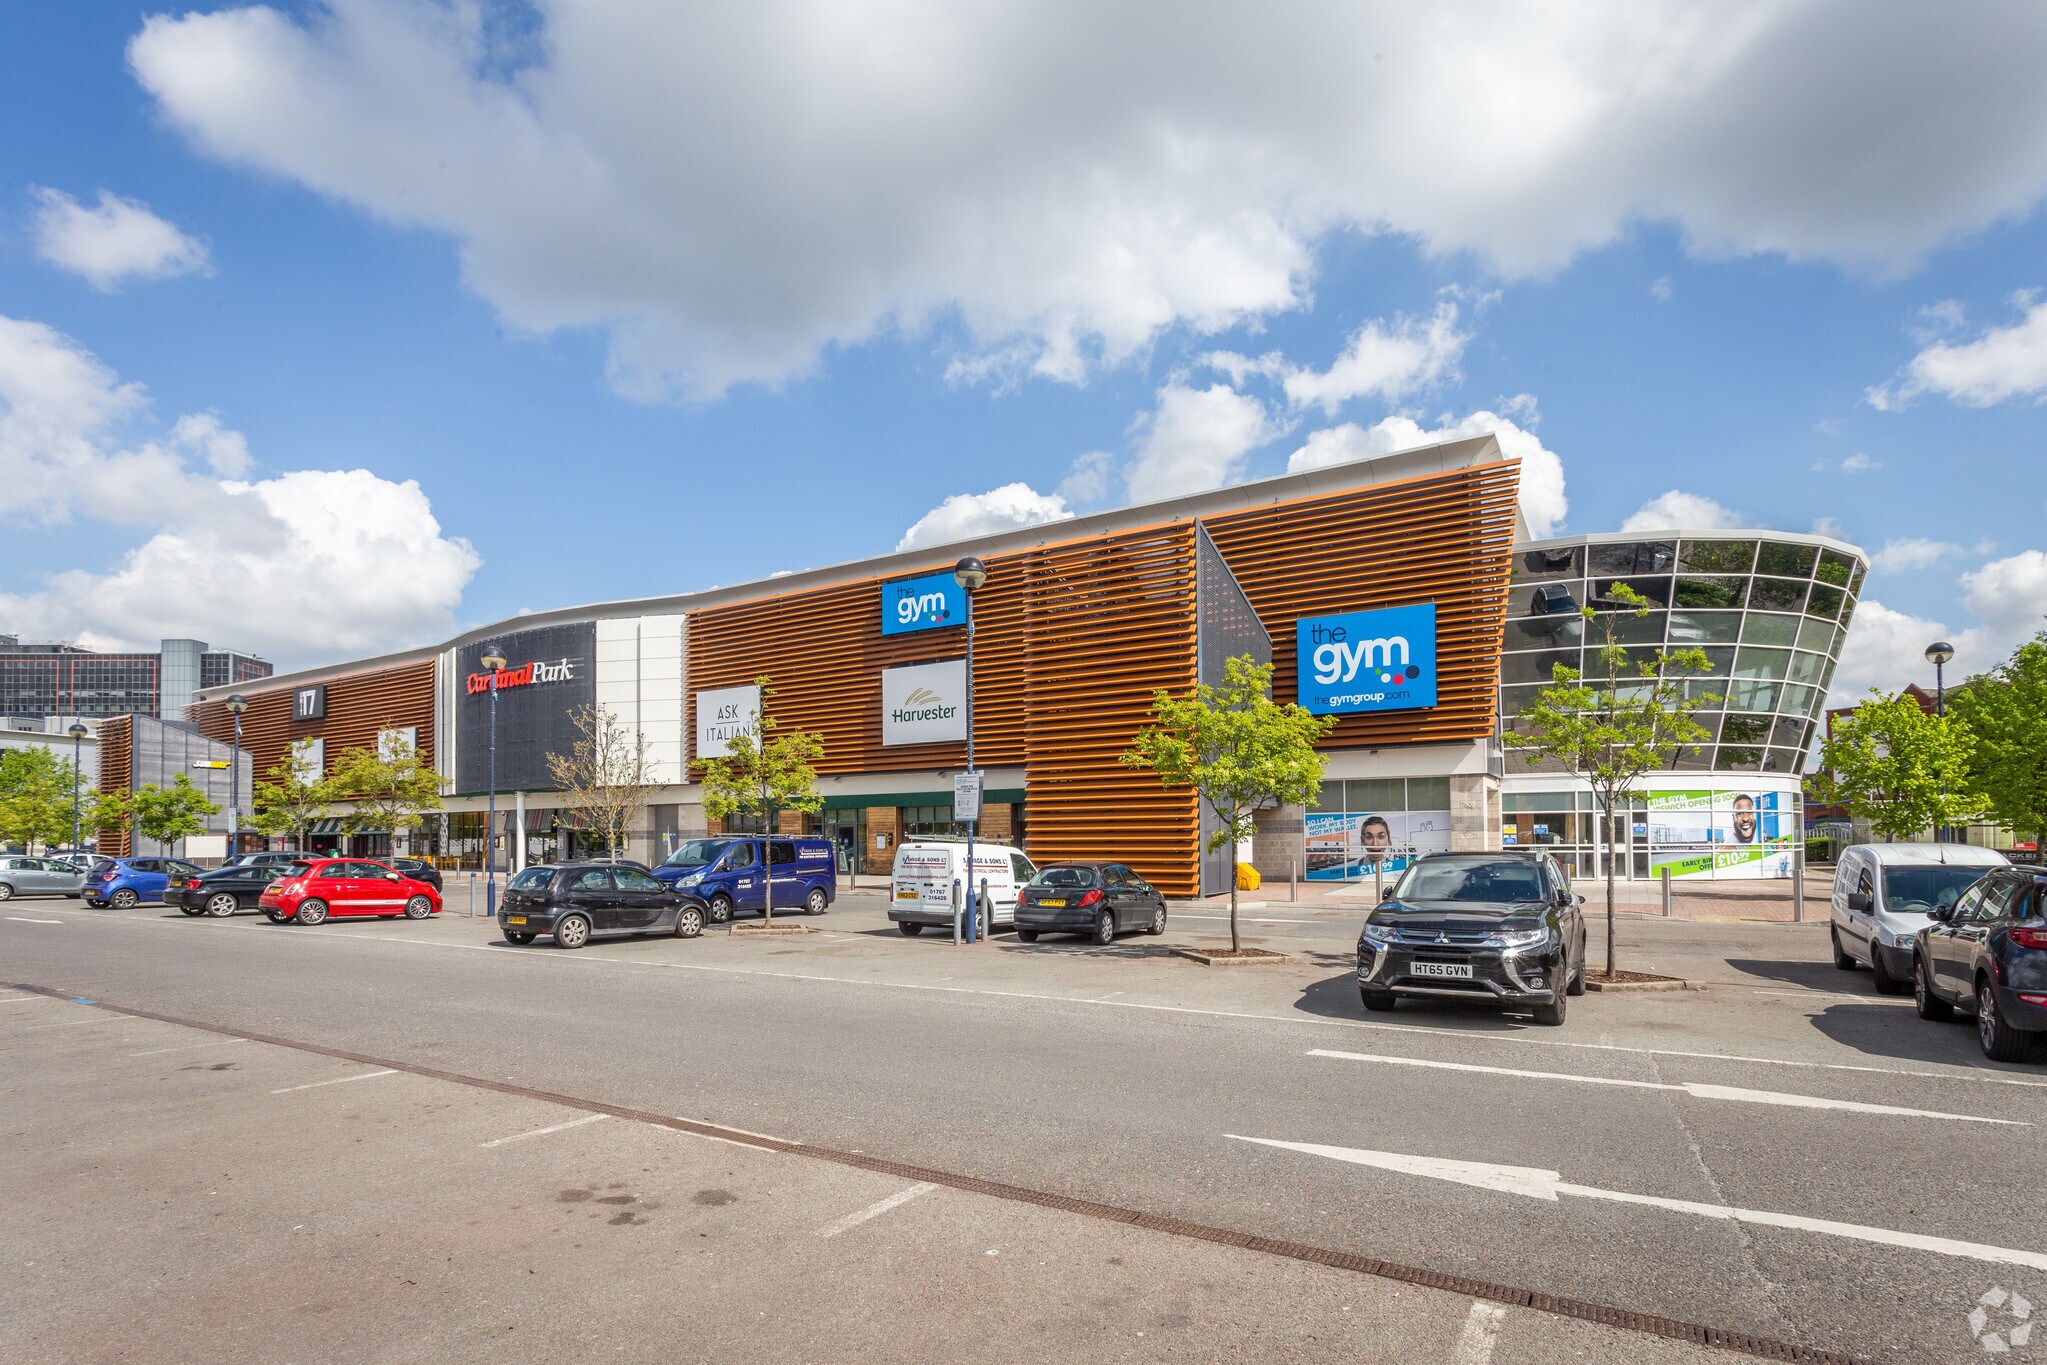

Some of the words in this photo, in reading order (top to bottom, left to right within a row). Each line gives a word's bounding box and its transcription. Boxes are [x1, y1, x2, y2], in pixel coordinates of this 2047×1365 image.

[896, 585, 915, 600] the
[897, 592, 946, 624] gym
[1311, 623, 1347, 645] the
[1313, 636, 1410, 685] gym
[303, 689, 316, 716] 17
[1314, 690, 1410, 707] thegymgroup.com
[717, 703, 739, 720] ASK
[891, 704, 957, 723] Harvester
[706, 724, 750, 742] ITALIAN
[192, 760, 231, 769] SUBWAY
[1652, 797, 1666, 806] THE
[1667, 794, 1687, 803] GYM
[1308, 823, 1327, 831] WORK
[1682, 859, 1700, 868] EARLY
[1702, 856, 1713, 864] BIR
[1415, 963, 1443, 975] HT65
[1446, 965, 1468, 976] GVN
